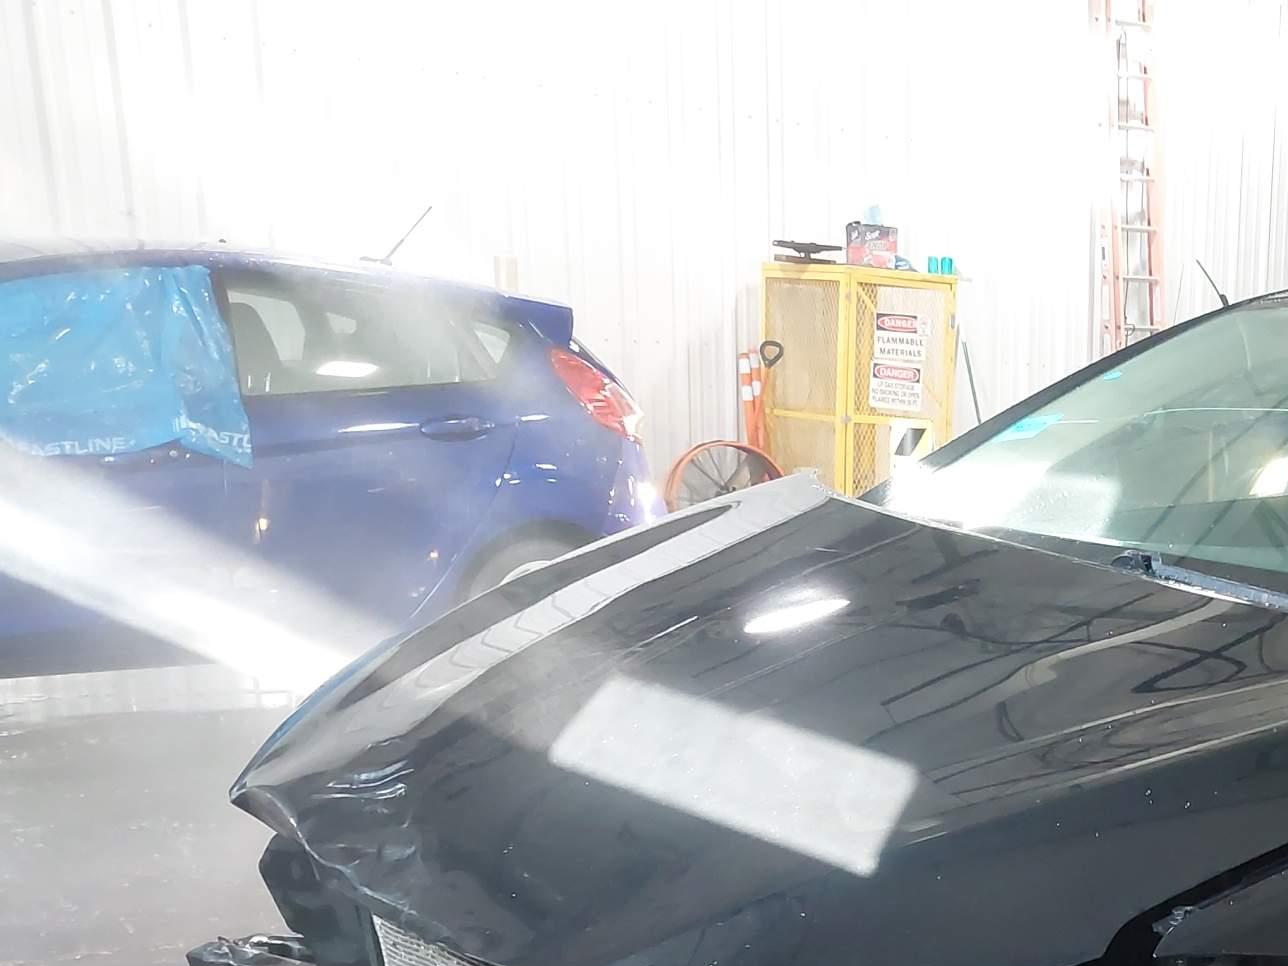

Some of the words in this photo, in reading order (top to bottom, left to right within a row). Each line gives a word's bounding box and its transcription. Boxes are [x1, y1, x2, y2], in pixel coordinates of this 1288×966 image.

[877, 336, 923, 346] FLAMMABLE
[880, 347, 921, 357] MATERIALS
[880, 367, 914, 379] DANGER
